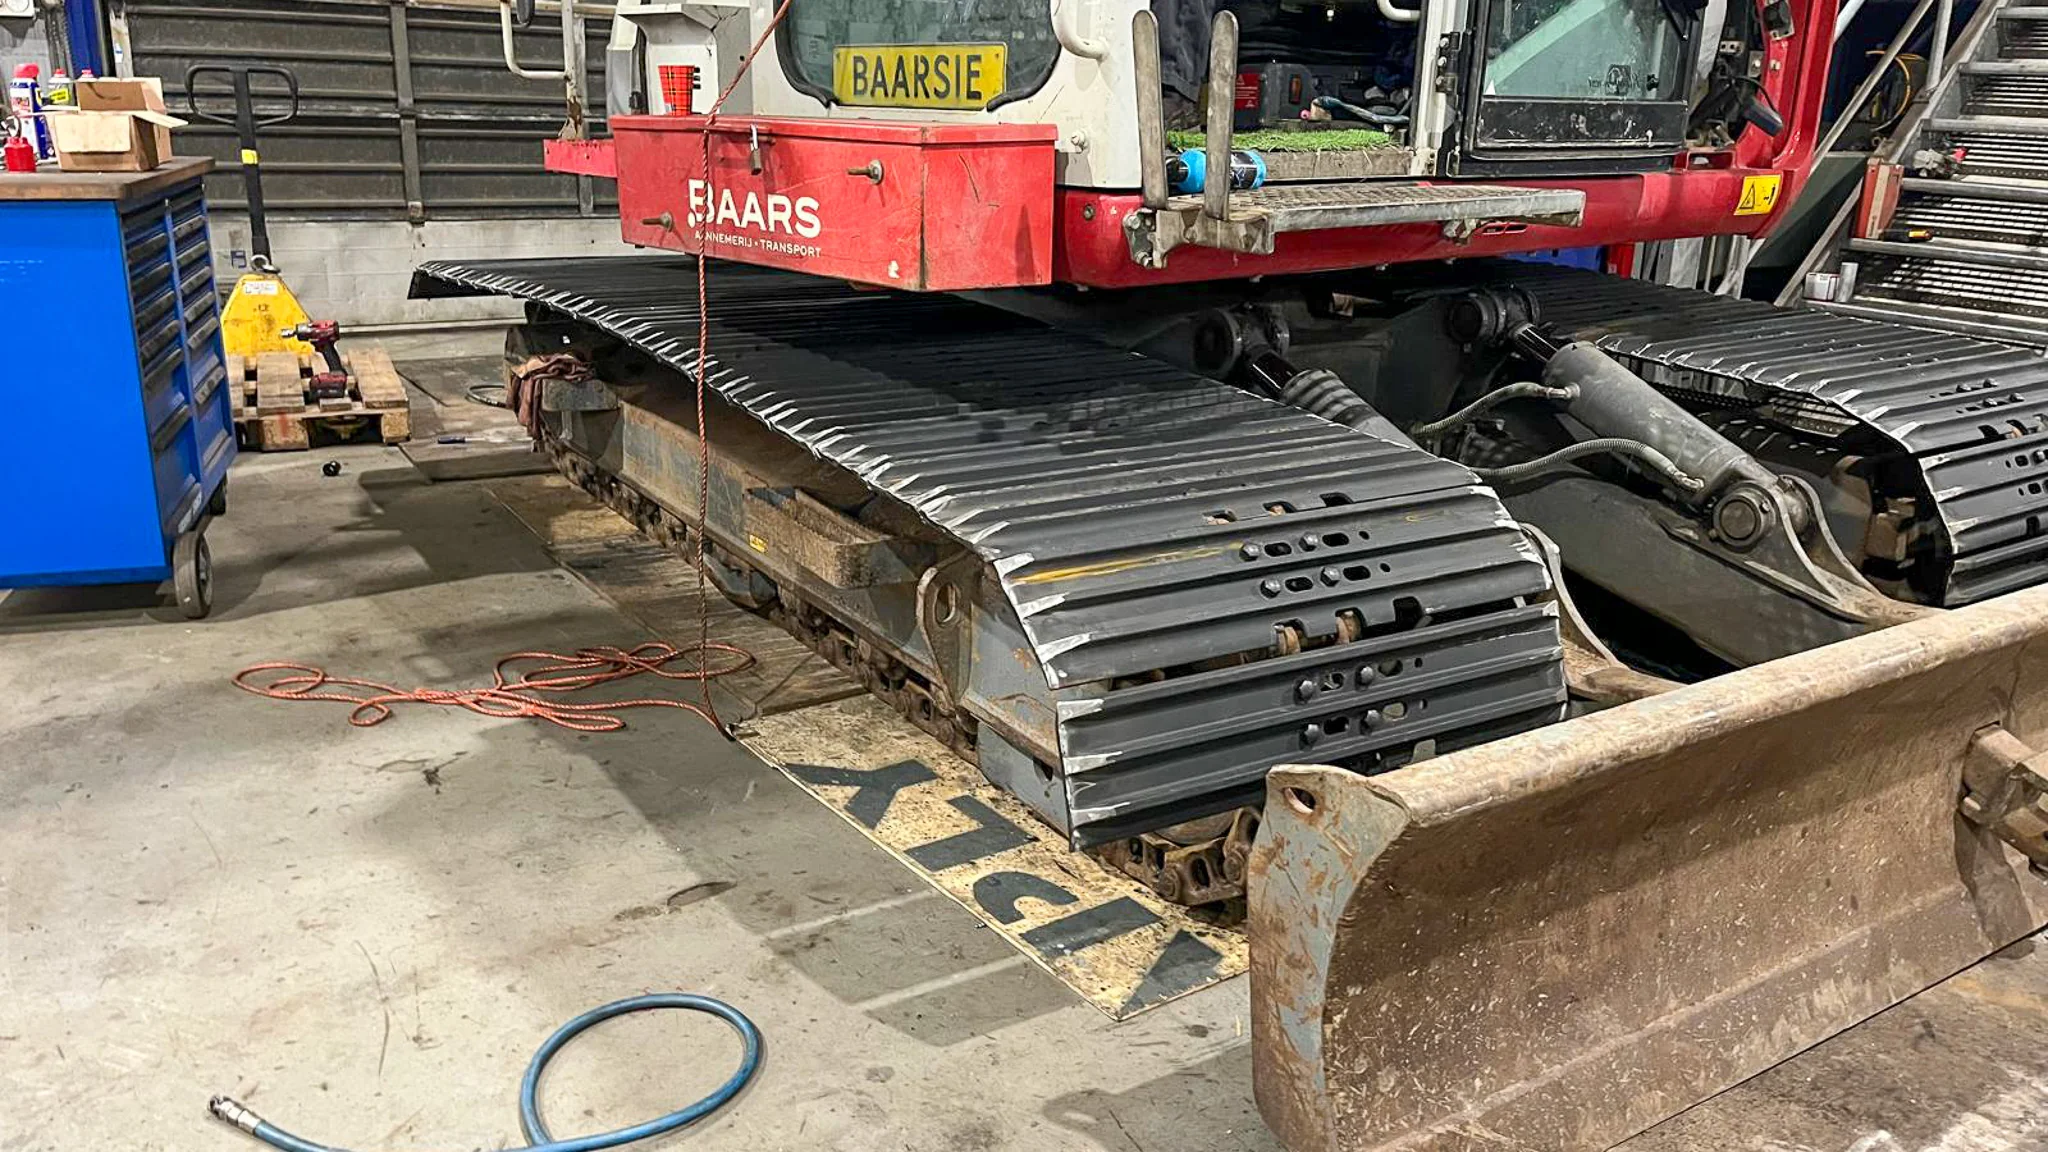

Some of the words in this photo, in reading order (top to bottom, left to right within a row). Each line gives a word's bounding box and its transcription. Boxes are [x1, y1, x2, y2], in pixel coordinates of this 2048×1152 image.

[853, 54, 982, 100] BAARSIE
[688, 179, 821, 238] BAARS
[695, 230, 752, 248] ANNEMERIJ
[760, 239, 822, 258] TRANSPORT
